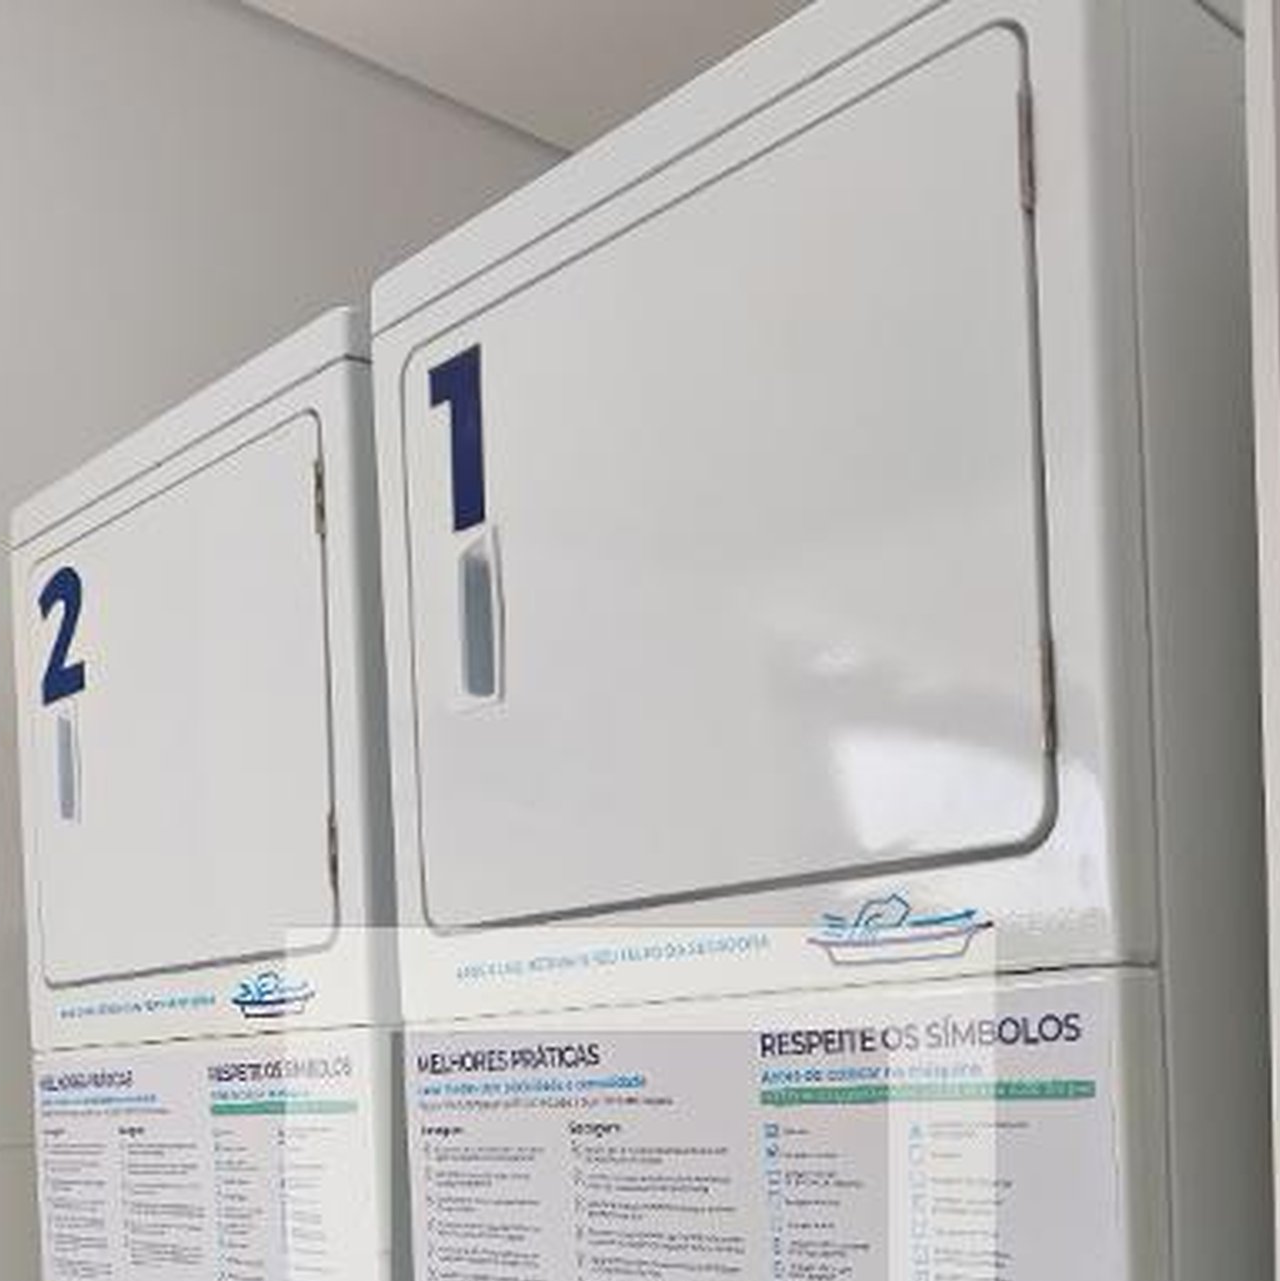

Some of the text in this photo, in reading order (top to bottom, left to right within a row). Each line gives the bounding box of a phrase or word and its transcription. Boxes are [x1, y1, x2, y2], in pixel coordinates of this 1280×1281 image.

[428, 343, 485, 533] 1
[37, 565, 86, 707] 2
[512, 1043, 601, 1070] PRÁTICAS
[760, 1013, 1082, 1058] RESPEITE OS SÍMBOLOS
